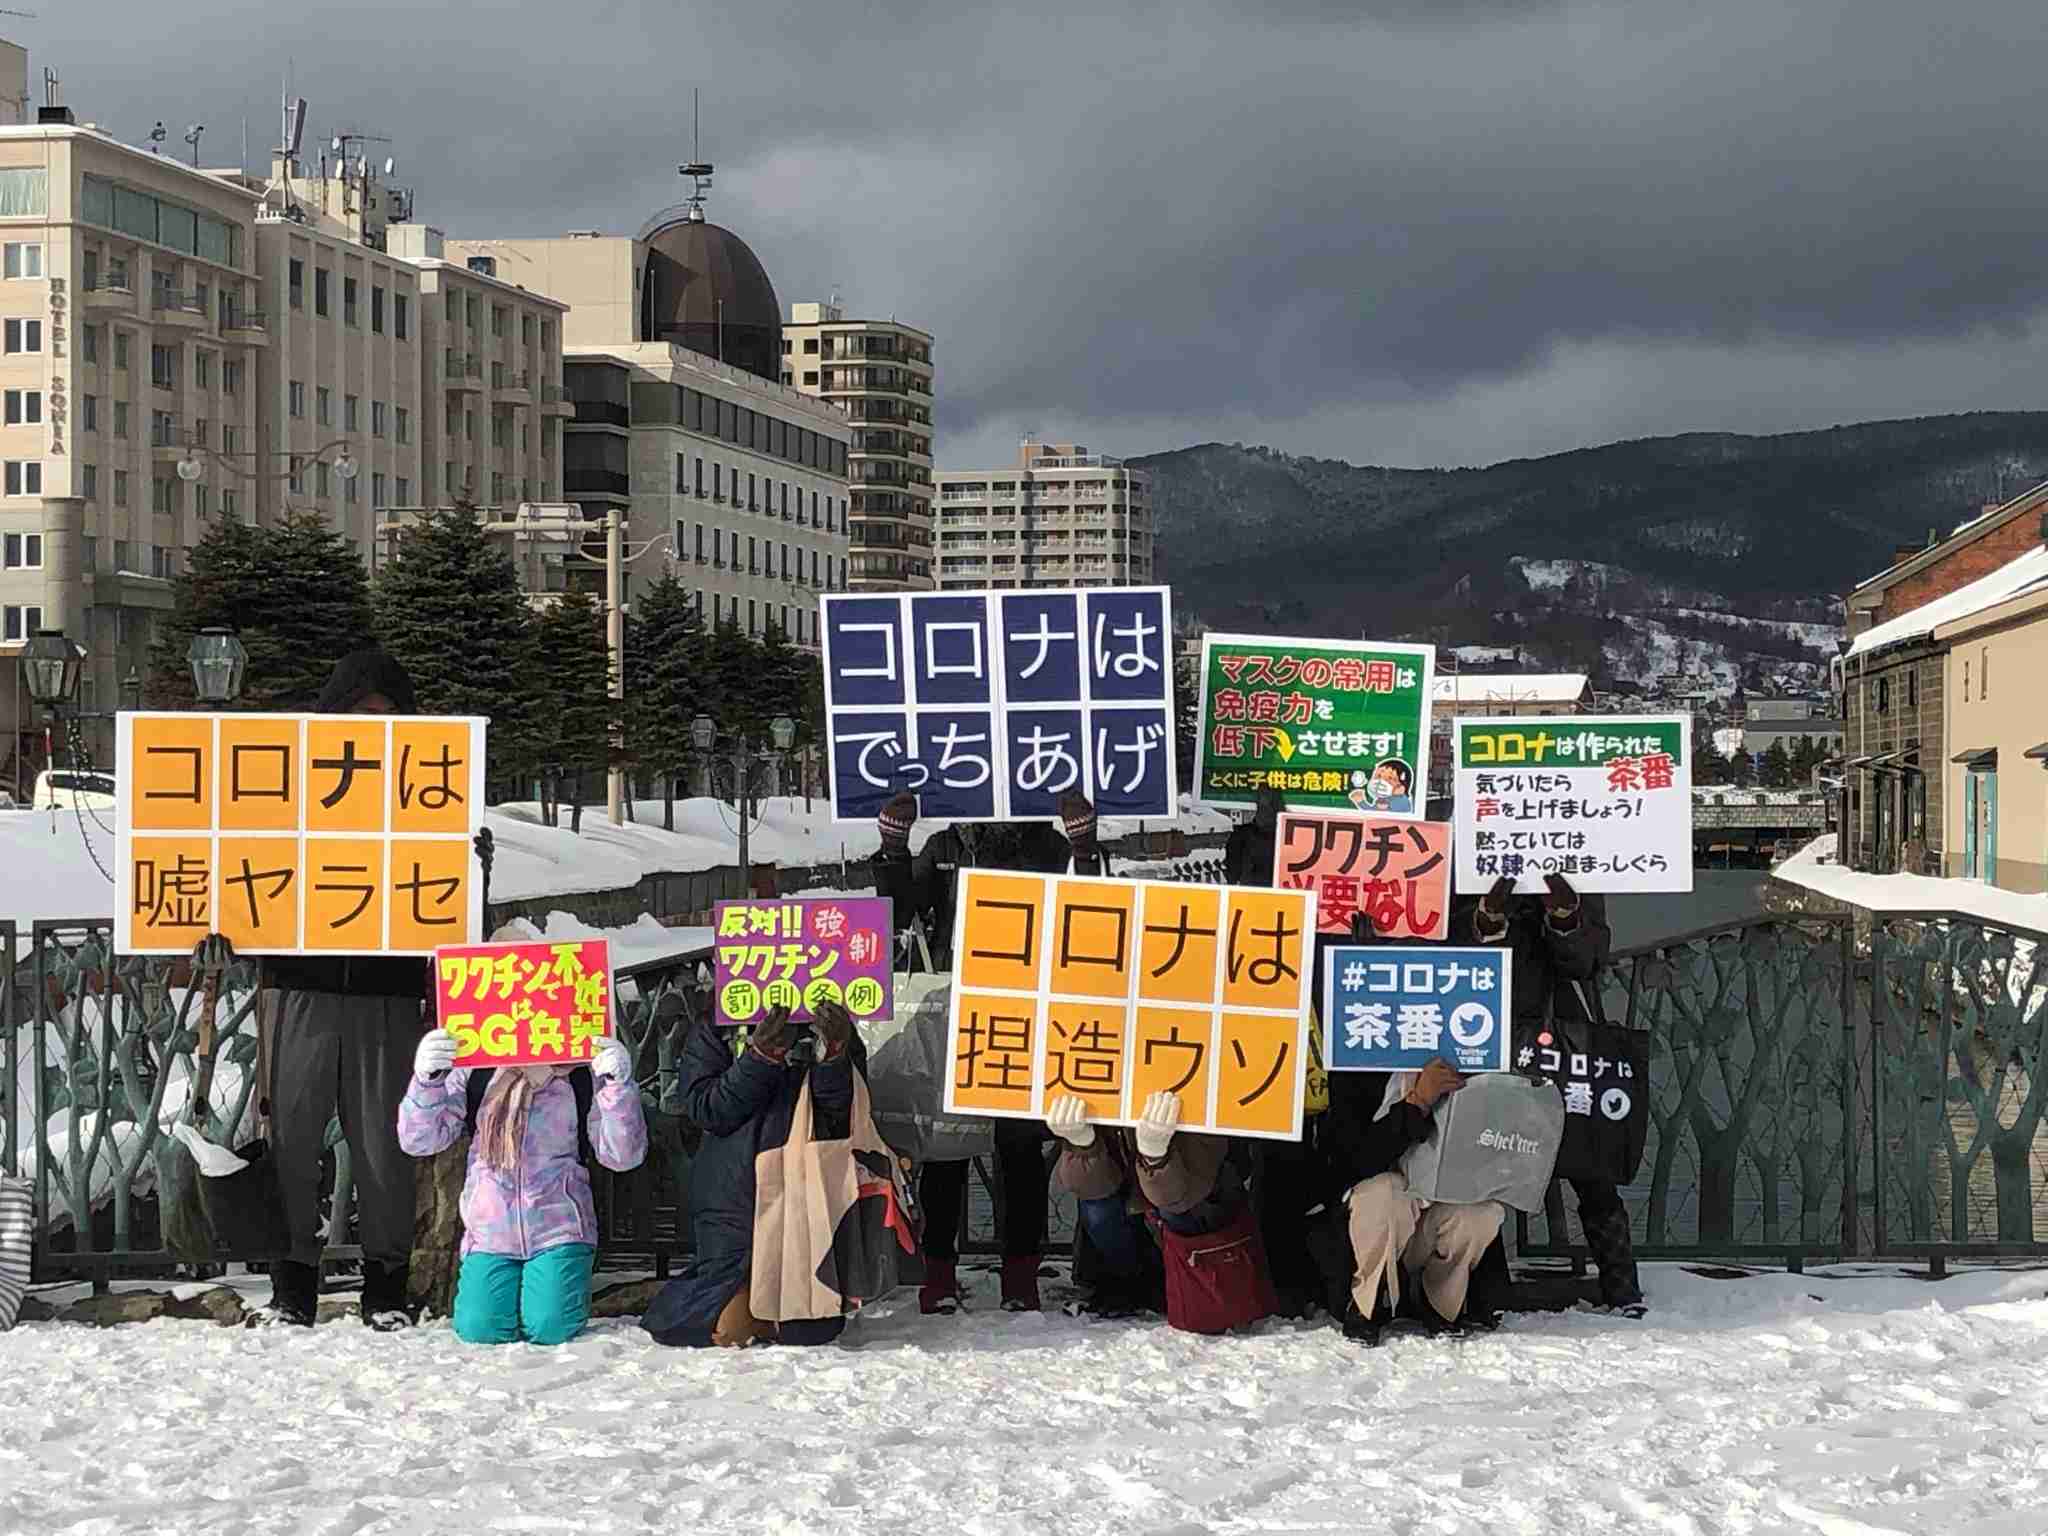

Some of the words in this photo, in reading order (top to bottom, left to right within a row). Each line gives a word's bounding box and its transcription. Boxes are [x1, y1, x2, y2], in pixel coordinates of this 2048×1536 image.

[50, 278, 66, 358] HOTEL
[839, 612, 1160, 680] コロナは
[1218, 654, 1417, 694] マスクの常用は
[1213, 688, 1335, 725] 免疫力を
[834, 722, 1165, 794] でっちあげ
[1469, 731, 1662, 762] コロナは作られた
[144, 740, 465, 810] コロナは
[1209, 770, 1349, 791] とくに子供は危険!
[1475, 773, 1573, 795] 気づいたら
[1605, 753, 1675, 792] 茶番
[1475, 798, 1644, 822] 声を上げましょう!
[1284, 819, 1444, 878] ワクチン
[1475, 831, 1587, 851] 黙っていては
[1475, 854, 1668, 876] 奴隷への道まっしぐら
[134, 854, 461, 928] 嘘ヤラセ
[971, 899, 1300, 985] コロナは
[719, 944, 840, 981] ワクチン
[1341, 961, 1496, 995] #コロナは
[1343, 1002, 1443, 1050] 茶番
[956, 1011, 1289, 1107] 捏造ウソ
